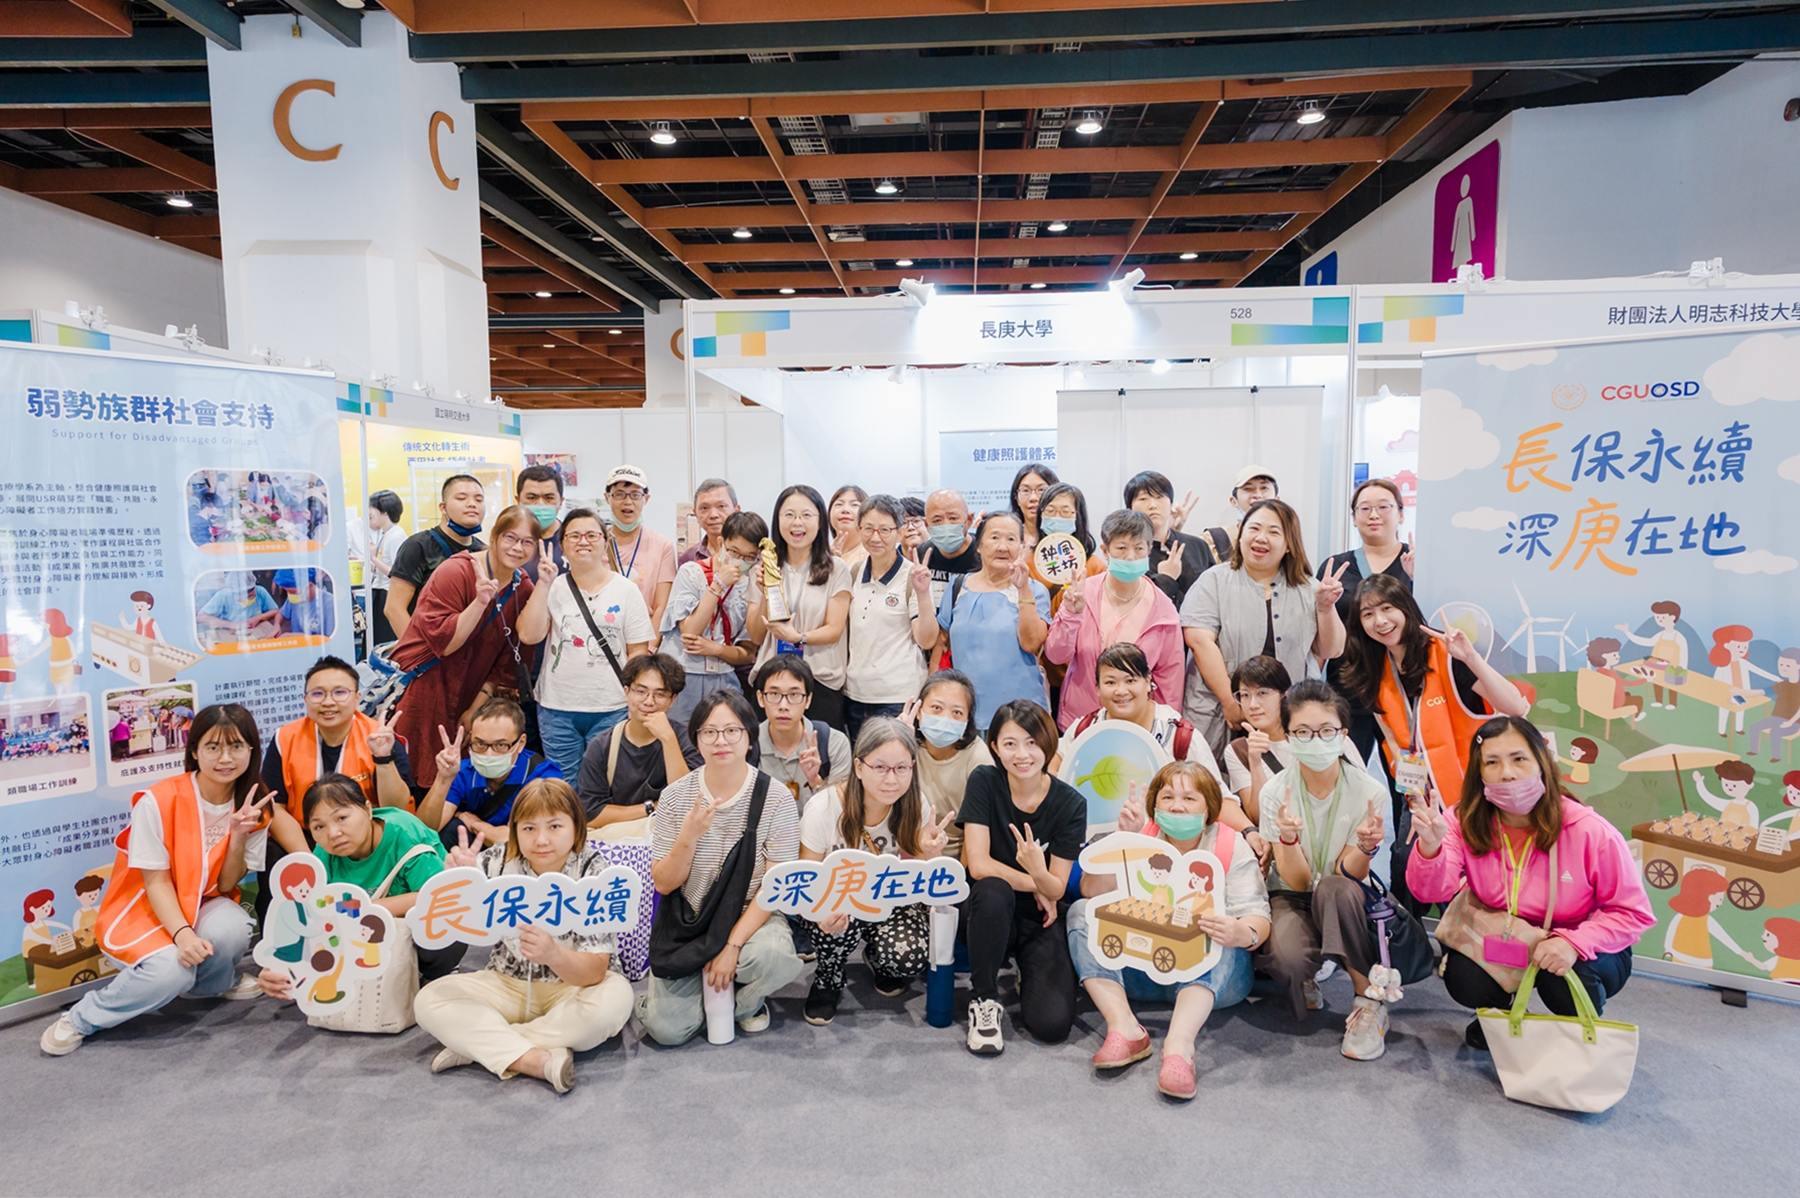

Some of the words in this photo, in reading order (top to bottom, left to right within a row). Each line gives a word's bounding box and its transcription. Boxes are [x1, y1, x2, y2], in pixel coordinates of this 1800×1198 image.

[273, 79, 342, 162] C
[428, 111, 460, 190] C
[1230, 308, 1253, 319] 528
[980, 319, 1053, 339] 長庚大學
[1601, 381, 1700, 401] CGUOSD
[27, 387, 275, 430] 弱勢族群社會支持
[52, 428, 105, 440] Support
[110, 431, 127, 441] for
[133, 432, 217, 446] Disadvantaged
[222, 437, 259, 447] Groups
[402, 441, 470, 452] 傳統文化轉生術
[973, 446, 1056, 462] 健康照護體系
[1502, 421, 1753, 493] 長保永續
[1498, 497, 1747, 576] 深庚在地
[215, 674, 307, 692] 計畫執行期間，完成多場實
[120, 759, 185, 777] 庇護及支持性就
[7, 777, 77, 796] 類職場工作訓練
[0, 837, 115, 867] 大眾對身心障礙者職涯挑
[767, 859, 959, 914] 深庚在地
[419, 876, 631, 940] 長保永續
